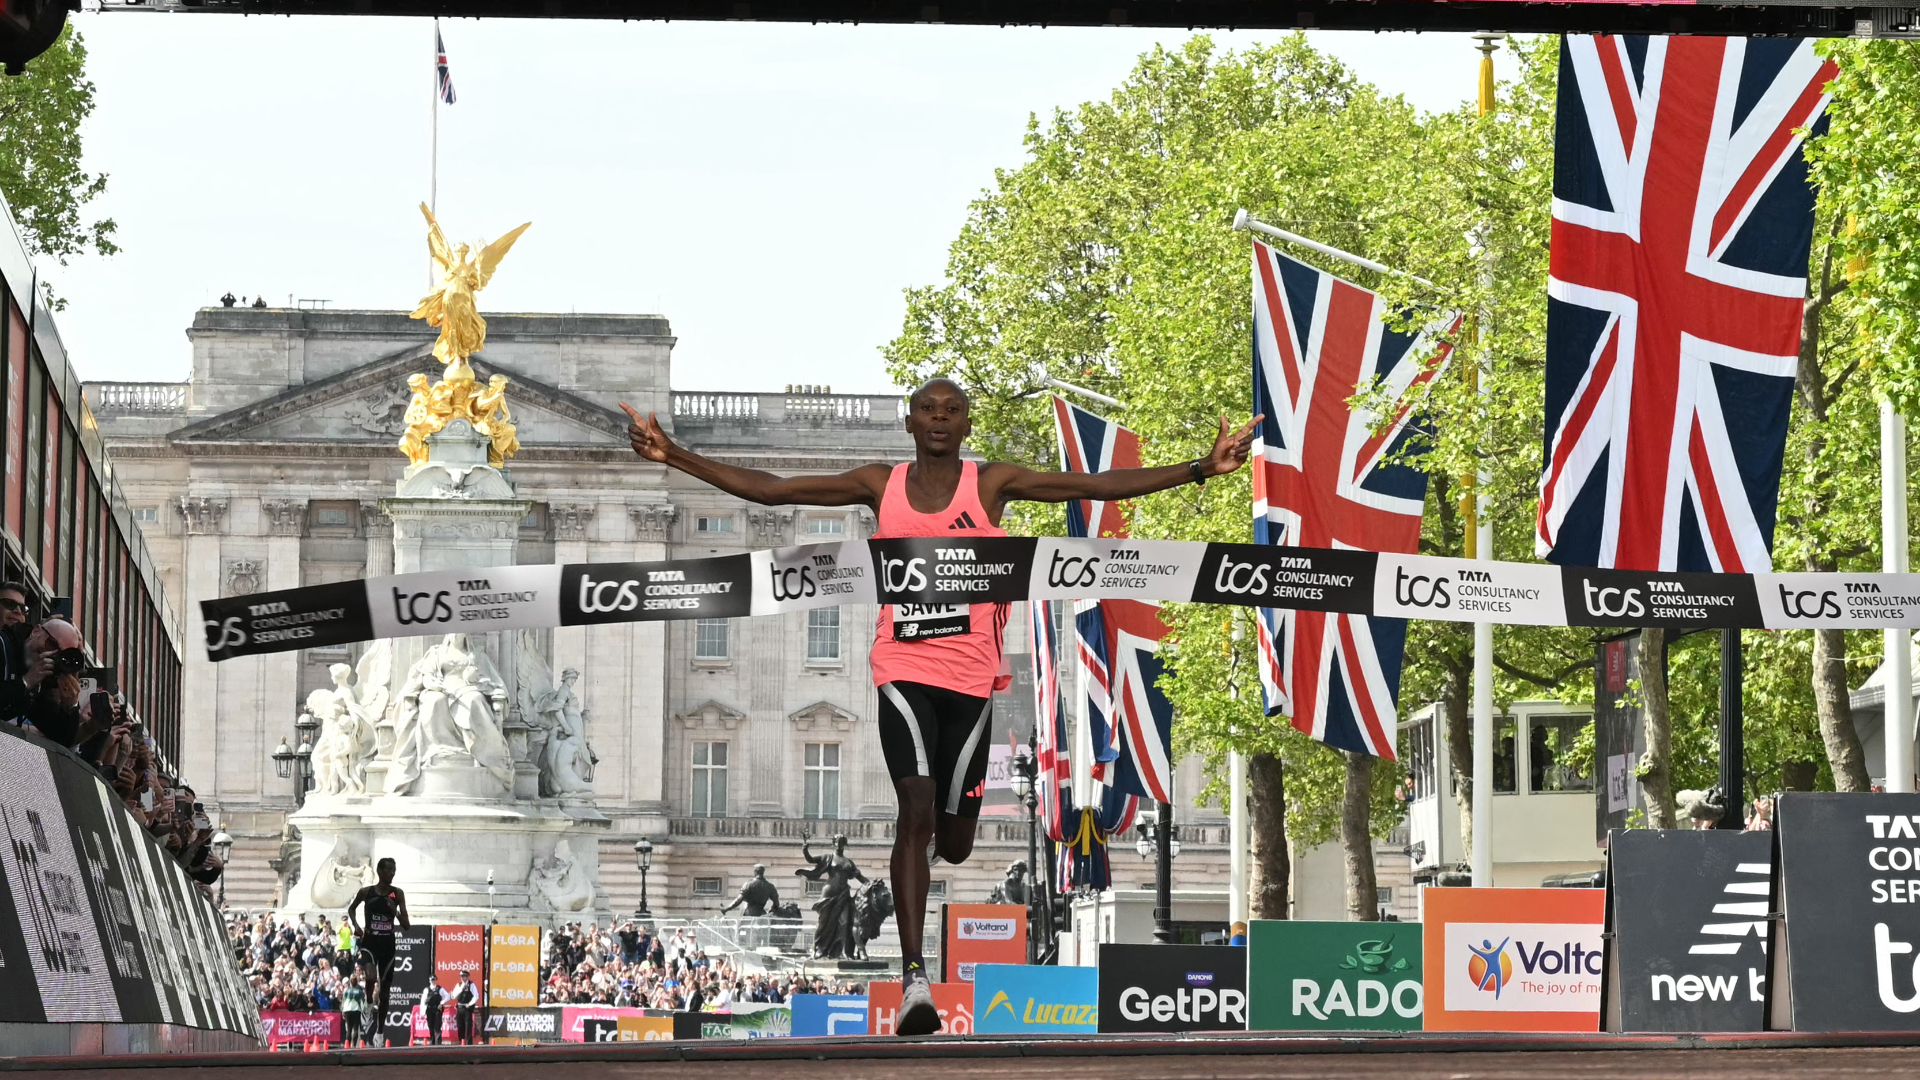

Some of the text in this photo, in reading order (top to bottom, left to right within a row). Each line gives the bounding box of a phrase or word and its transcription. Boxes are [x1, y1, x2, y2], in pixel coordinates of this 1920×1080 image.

[812, 554, 836, 566] TATA
[935, 548, 977, 561] TATA
[1110, 549, 1140, 560] TATA
[935, 563, 1015, 576] CONSULTANCY
[1048, 548, 1100, 588] tcs
[1104, 563, 1180, 576] CONSULTANCY
[1280, 557, 1312, 569] TATA
[647, 571, 685, 582] TATA
[817, 566, 865, 581] CONSULTANCY
[880, 551, 927, 593] tcs
[1215, 553, 1271, 596] tcs
[1458, 570, 1492, 583] TATA
[457, 579, 491, 592] TATA
[770, 561, 816, 602] tcs
[935, 579, 990, 592] SERVICES
[1100, 577, 1147, 588] SERVICES
[1275, 571, 1354, 587] CONSULTANCY
[645, 582, 733, 596] CONSULTANCY
[821, 582, 854, 596] SERVICES
[1273, 586, 1324, 600] SERVICES
[1396, 565, 1451, 609] tcs
[1458, 585, 1540, 600] CONSULTANCY
[1647, 581, 1685, 592] TATA
[1844, 583, 1881, 593] TATA
[458, 591, 538, 607] CONSULTANCY
[579, 574, 640, 614] tcs
[1583, 578, 1645, 617] tcs
[1650, 594, 1735, 606] CONSULTANCY
[392, 586, 453, 625] tcs
[643, 598, 700, 610] SERVICES
[1459, 599, 1512, 612] SERVICES
[1779, 583, 1842, 619] tcs
[1847, 596, 1920, 606] CONSULTANC
[248, 601, 290, 616] TATA
[460, 608, 510, 621] SERVICES
[1652, 607, 1708, 619] SERVICES
[1849, 609, 1905, 619] SERVICES
[251, 608, 345, 629] CONSULTANCY
[253, 626, 315, 643] SERVICES
[934, 626, 963, 634] balance
[975, 922, 1008, 931] Voltarol
[438, 931, 480, 943] HubSpot
[494, 935, 536, 946] FLORA
[438, 960, 480, 972] HubSpot
[493, 962, 535, 973] FLORA
[492, 988, 534, 999] FLORA
[1521, 981, 1544, 993] The
[1547, 981, 1566, 995] joy
[1570, 981, 1582, 993] of
[1651, 974, 1738, 1002] new
[1119, 986, 1245, 1023] GetPR
[1292, 978, 1423, 1020] RADO
[293, 1019, 330, 1027] LONDON
[521, 1014, 555, 1023] LONDON
[279, 1027, 330, 1036] MARATHON
[507, 1023, 555, 1032] MARATHON
[703, 1025, 731, 1036] TAG
